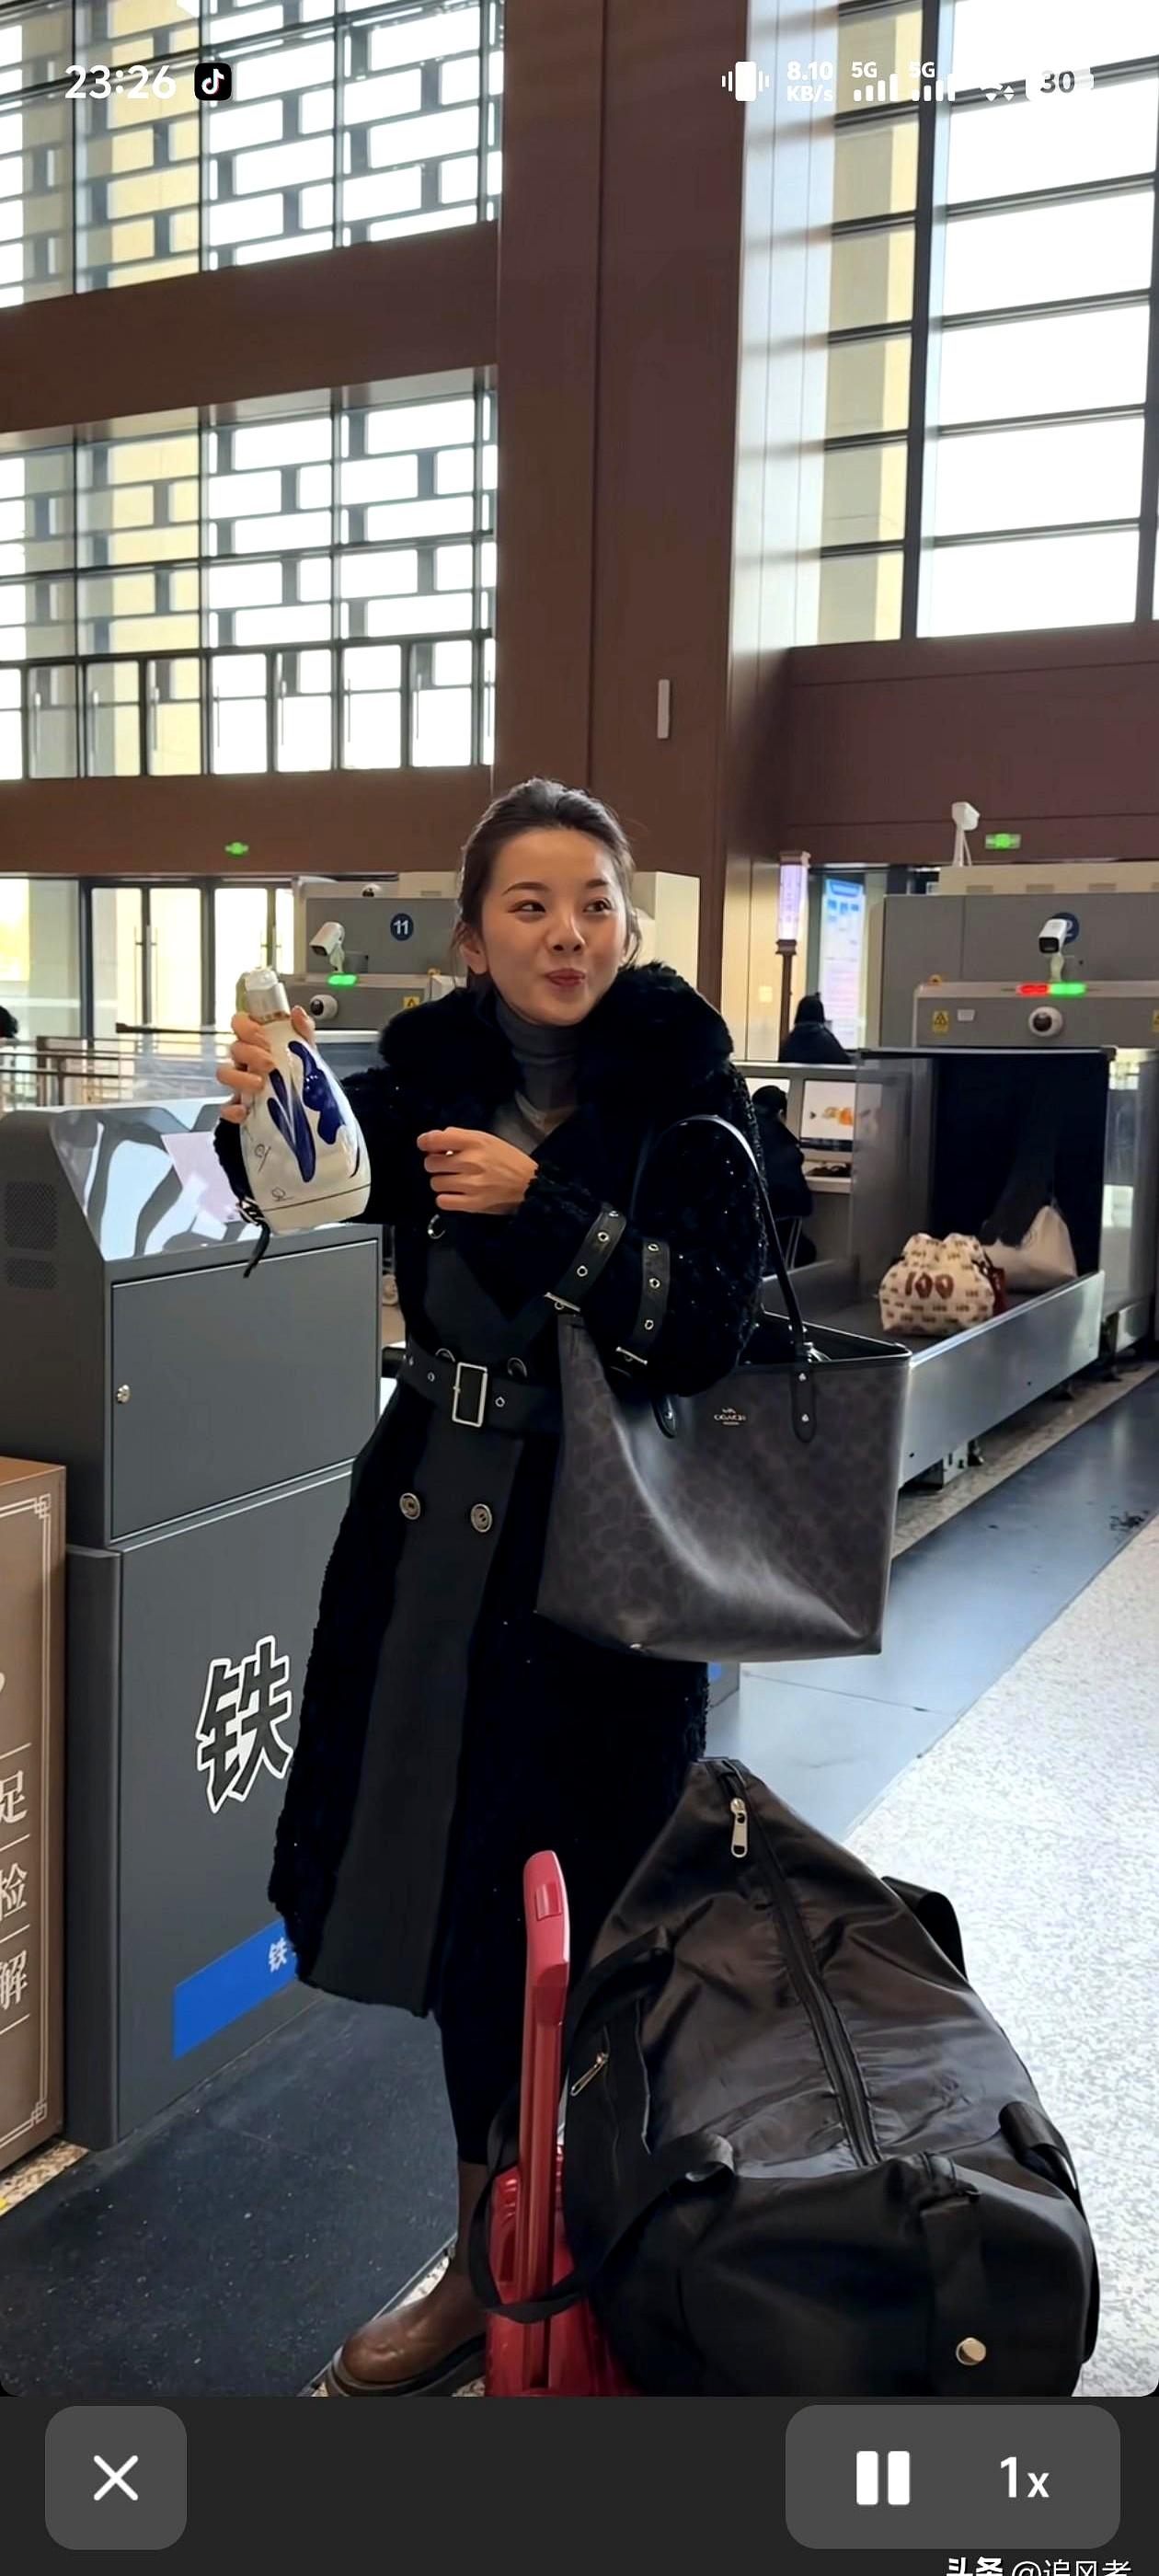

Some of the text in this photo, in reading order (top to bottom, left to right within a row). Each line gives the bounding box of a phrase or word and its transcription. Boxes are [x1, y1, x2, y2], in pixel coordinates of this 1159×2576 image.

[393, 920, 408, 936] 11
[905, 1272, 954, 1299] 100
[195, 1635, 293, 1814] 铁
